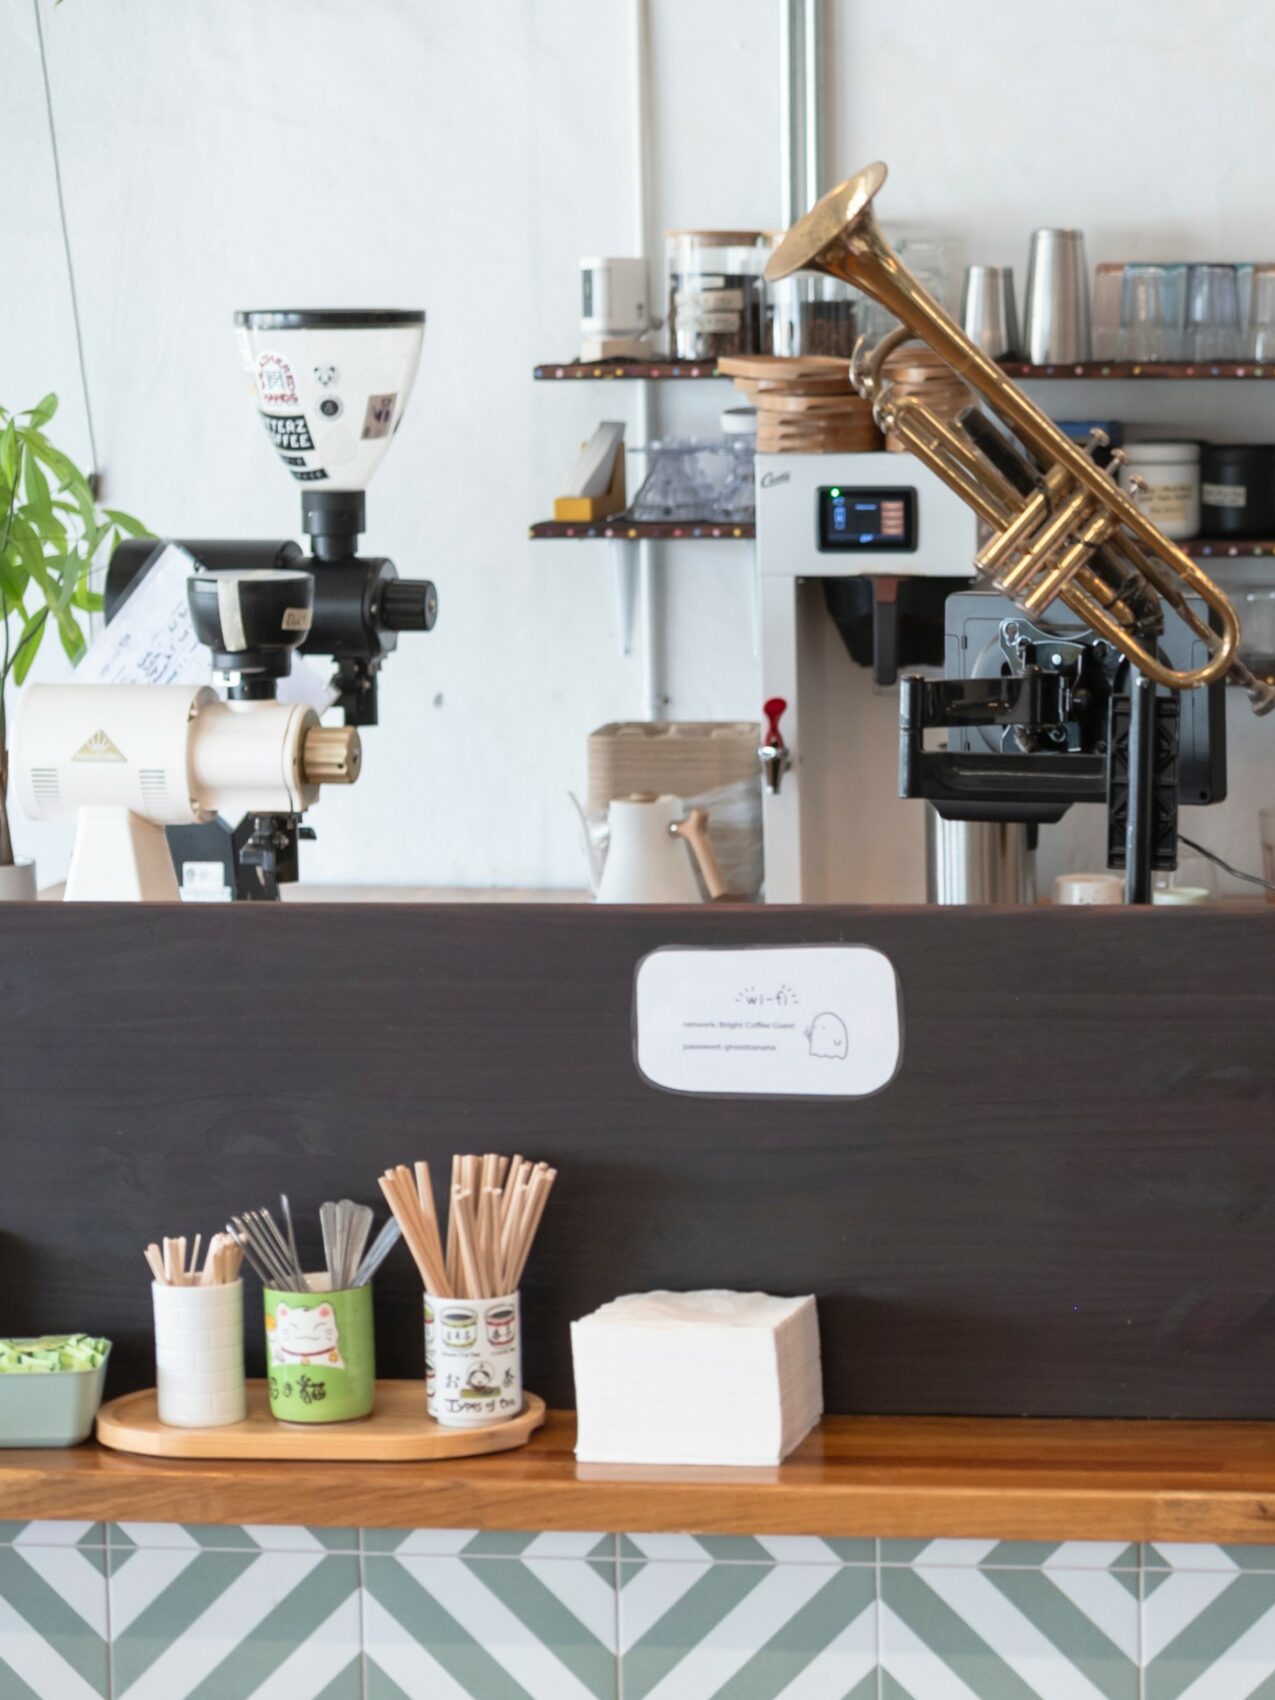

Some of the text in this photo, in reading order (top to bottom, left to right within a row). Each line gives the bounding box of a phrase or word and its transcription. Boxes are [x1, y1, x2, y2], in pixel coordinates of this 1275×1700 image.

[746, 990, 788, 1006] wi-fi
[718, 1021, 743, 1031] Bright
[745, 1021, 770, 1029] Coffee
[771, 1022, 795, 1030] Guest
